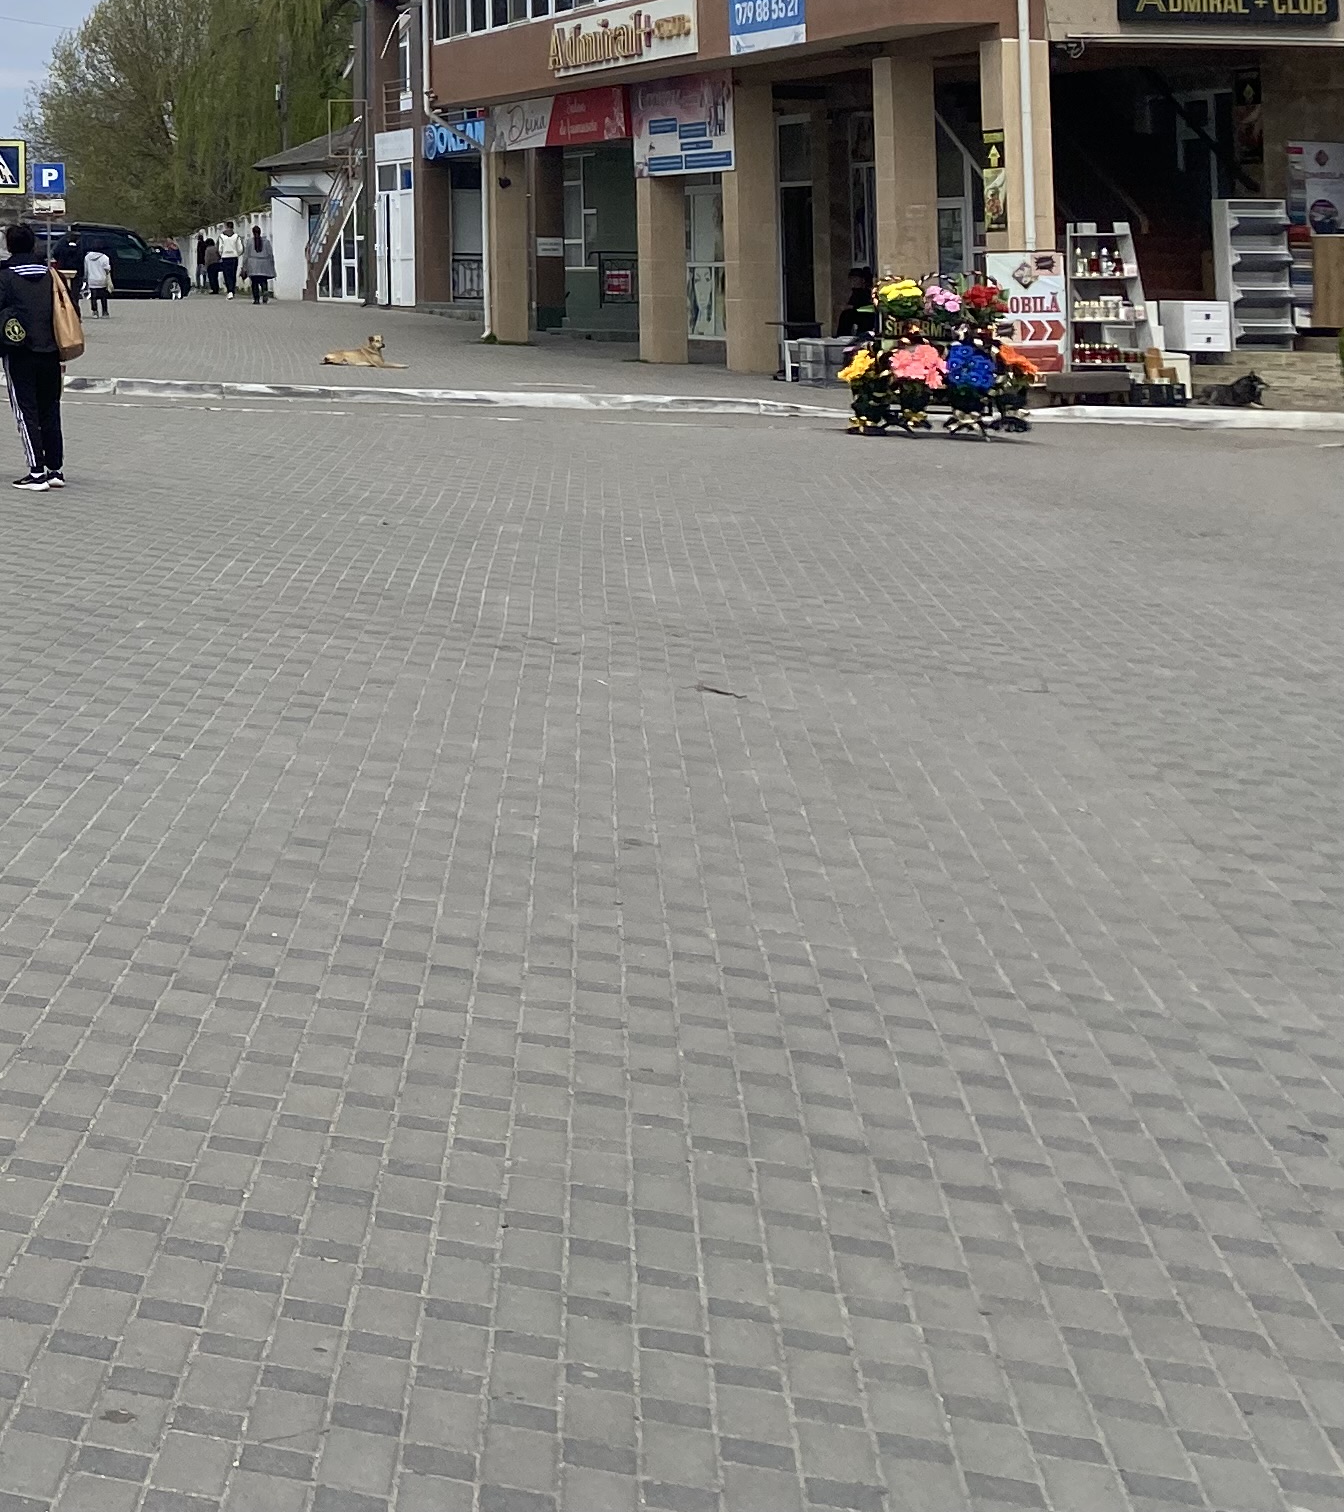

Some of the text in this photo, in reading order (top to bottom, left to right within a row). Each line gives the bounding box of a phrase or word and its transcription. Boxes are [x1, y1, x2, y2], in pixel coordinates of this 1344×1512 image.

[734, 1, 754, 25] 079
[42, 168, 59, 188] P
[1009, 291, 1061, 313] OBILĂ
